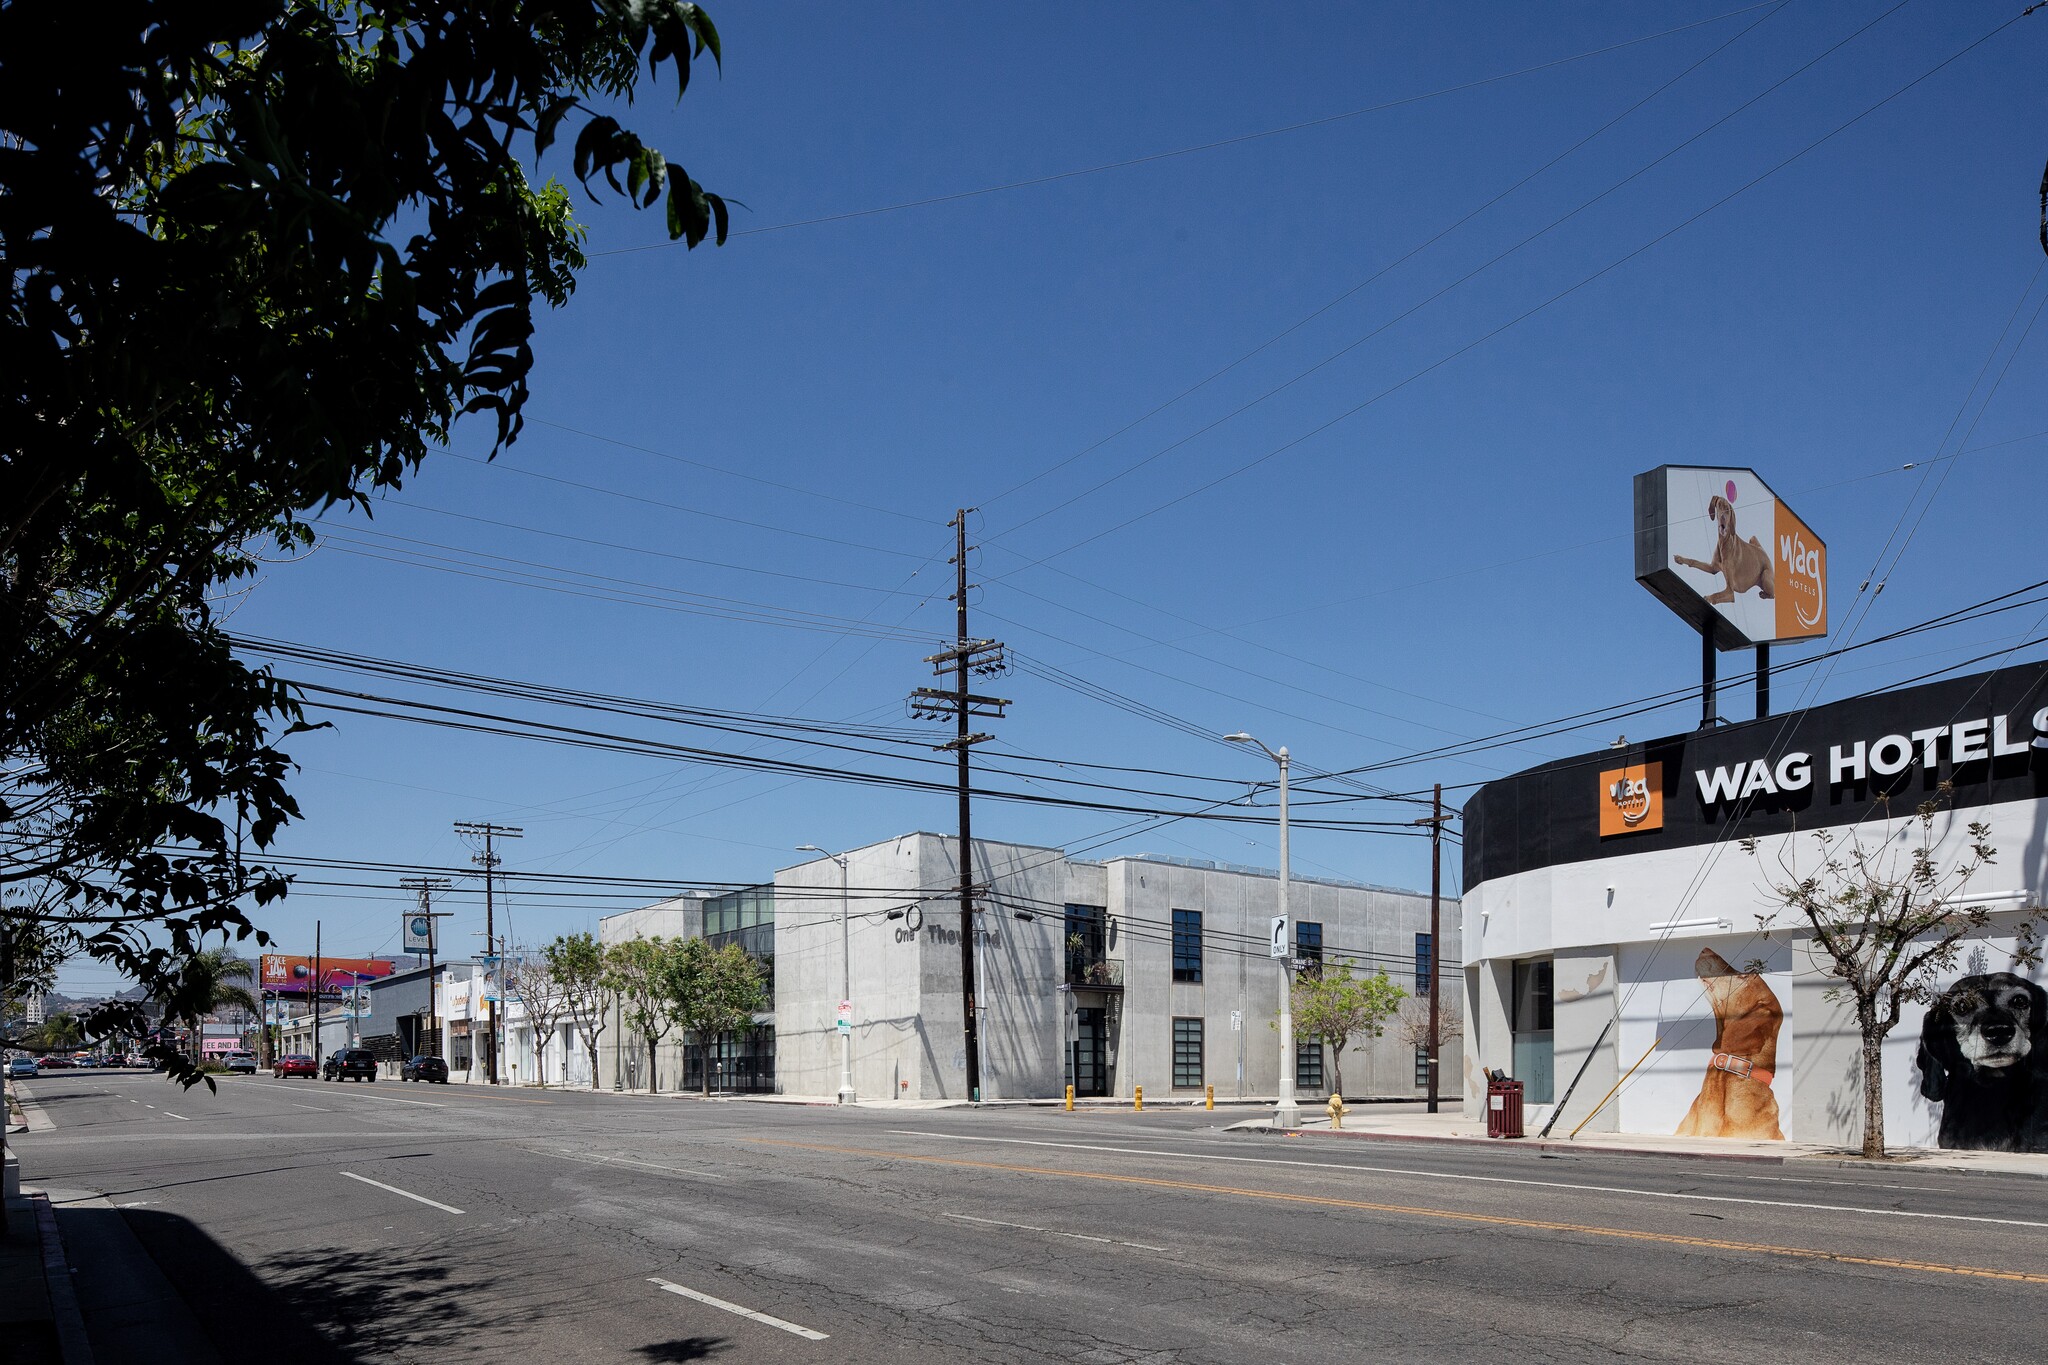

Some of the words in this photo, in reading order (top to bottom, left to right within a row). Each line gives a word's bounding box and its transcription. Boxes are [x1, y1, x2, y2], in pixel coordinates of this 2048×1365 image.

[1780, 531, 1823, 626] Wag
[1789, 578, 1816, 597] HOTELS
[1694, 751, 1812, 804] WAG
[1609, 777, 1651, 823] Wag
[1273, 944, 1286, 955] ONLY
[266, 963, 287, 977] JAM
[217, 1041, 232, 1049] AND
